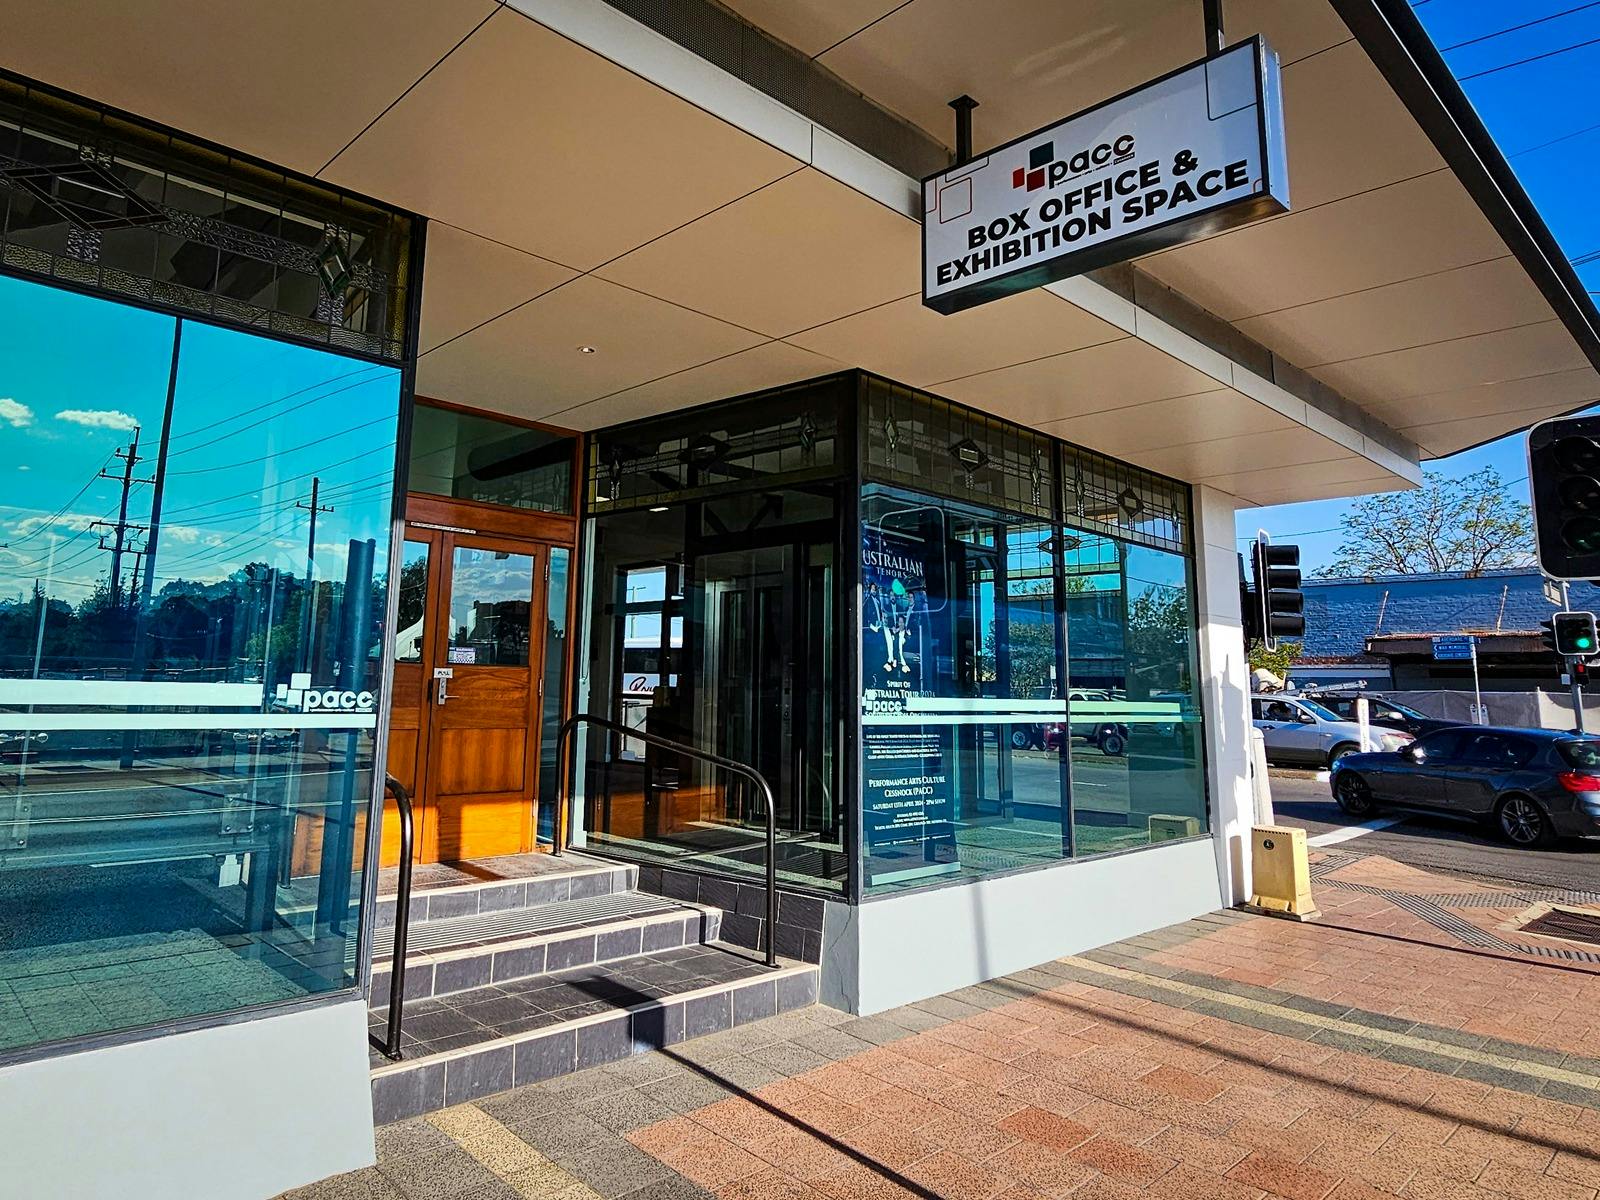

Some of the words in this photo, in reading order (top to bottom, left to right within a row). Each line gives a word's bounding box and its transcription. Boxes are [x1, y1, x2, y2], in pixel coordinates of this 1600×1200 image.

[1049, 134, 1135, 189] pacc
[968, 208, 1029, 250] BOX
[1039, 165, 1160, 222] OFFICE
[1172, 149, 1199, 176] &
[937, 209, 1112, 286] EXHIBITION
[1122, 160, 1249, 223] SPACE
[862, 549, 924, 577] USTRALIAN
[876, 566, 908, 579] TENORS
[303, 690, 373, 712] pacc
[864, 688, 900, 698] ASTRALIA
[873, 700, 903, 714] pacc
[868, 777, 908, 788] PERFORMANCE
[909, 777, 922, 785] ARTS
[922, 776, 946, 784] CULTURE
[884, 788, 913, 798] CESSNOCK
